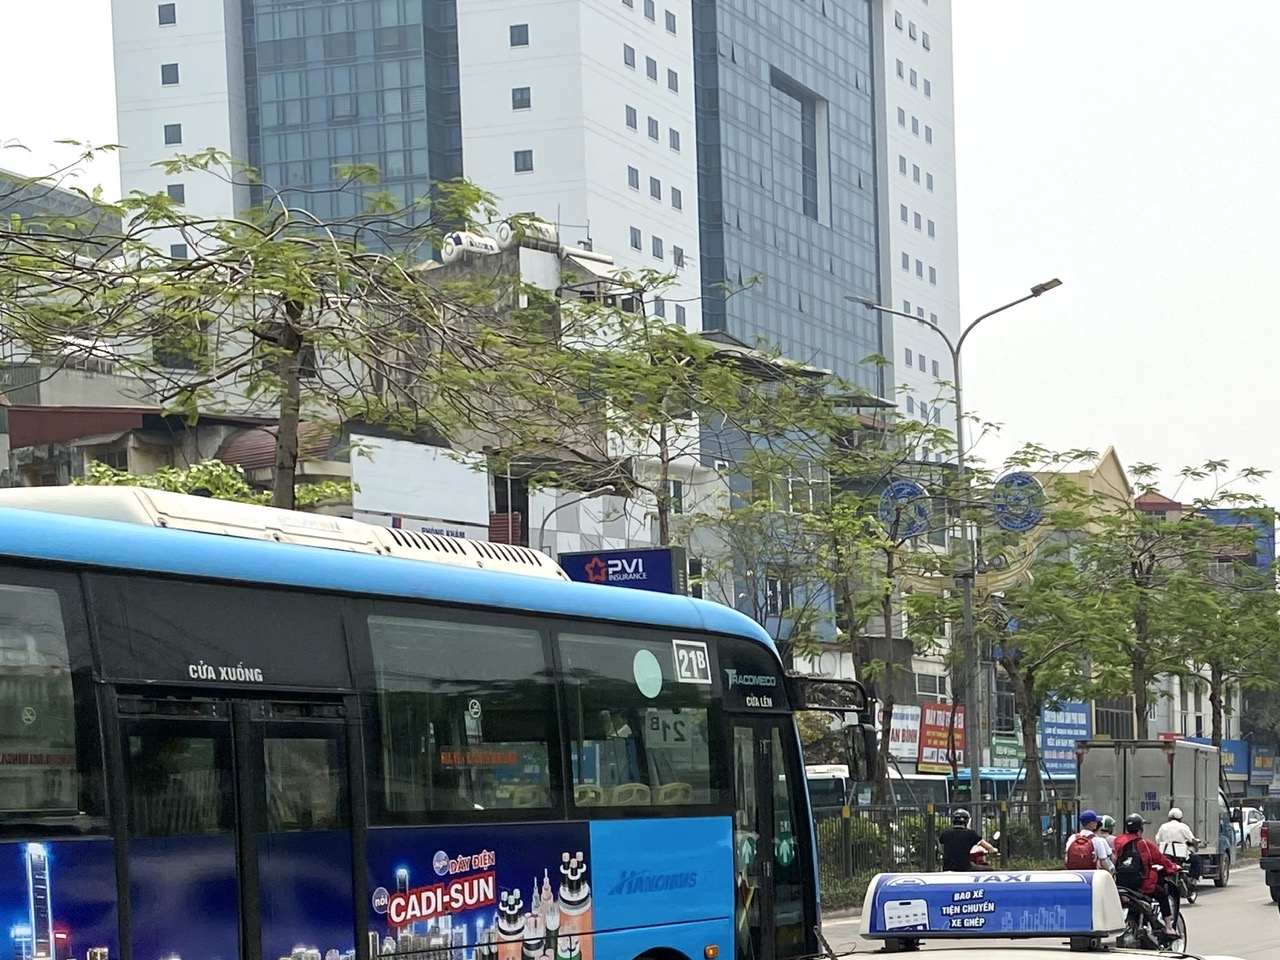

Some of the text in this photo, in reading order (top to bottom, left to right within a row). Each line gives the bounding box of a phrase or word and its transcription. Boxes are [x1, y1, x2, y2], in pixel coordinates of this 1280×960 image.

[608, 558, 643, 574] PVI
[609, 572, 647, 581] INSURANCE
[189, 660, 264, 682] CỬA XUỐNG
[679, 649, 706, 679] 21B
[724, 668, 777, 690] TRACOMECO
[970, 873, 1032, 883] TAXI
[390, 876, 494, 923] CADI-SUN
[954, 892, 972, 901] BAO
[942, 905, 960, 916] TIỆN
[951, 915, 985, 928] XE GHÉP
